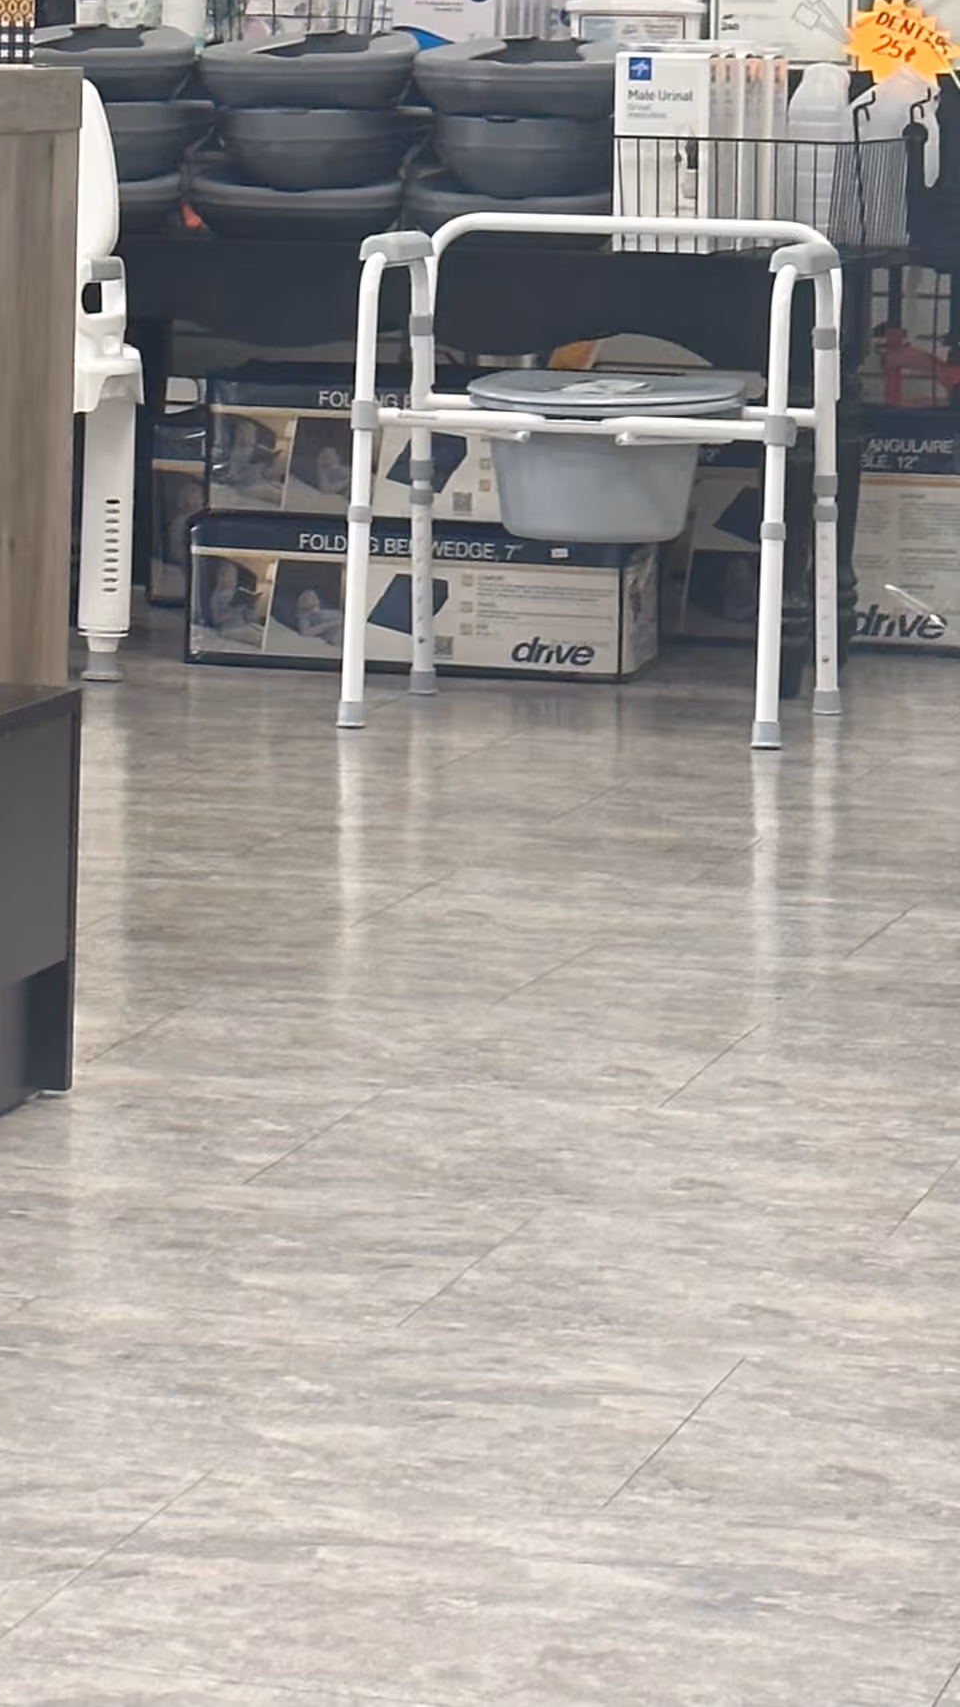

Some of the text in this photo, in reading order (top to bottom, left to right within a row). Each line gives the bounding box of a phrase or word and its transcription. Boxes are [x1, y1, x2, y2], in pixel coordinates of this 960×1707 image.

[627, 89, 693, 102] Male Urinal
[318, 390, 399, 408] FOLNG
[867, 438, 955, 455] ANGULAIRE
[897, 455, 919, 469] 12"
[299, 533, 379, 554] FOLDG
[511, 636, 595, 666] drive
